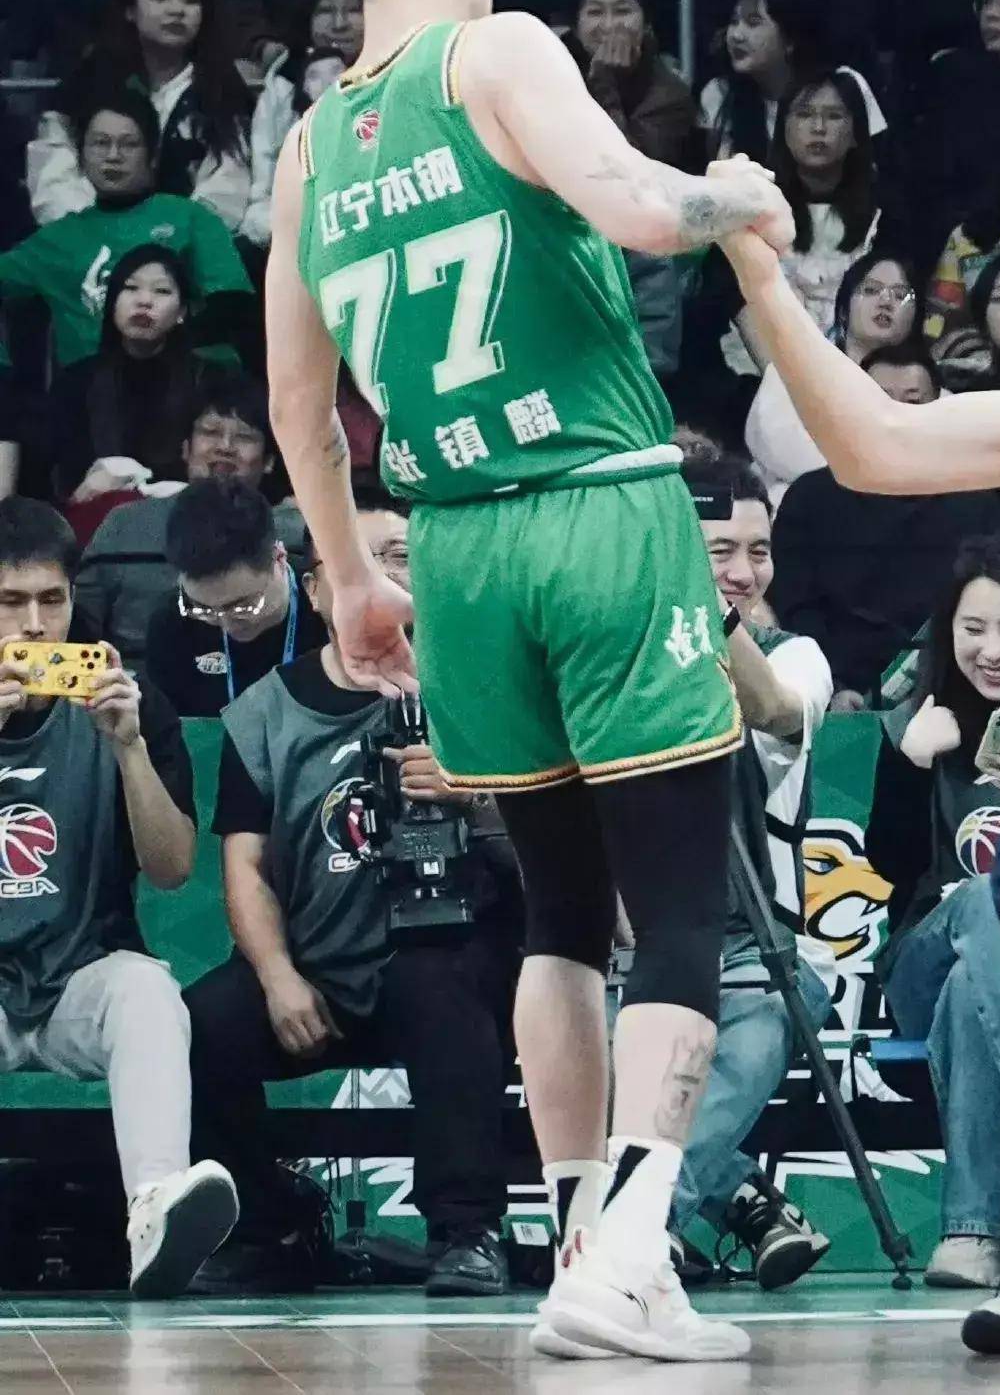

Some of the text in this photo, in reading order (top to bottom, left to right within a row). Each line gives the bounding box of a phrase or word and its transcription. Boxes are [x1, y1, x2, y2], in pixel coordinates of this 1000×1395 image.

[319, 145, 464, 246] 辽宁本钢
[318, 208, 513, 416] 77
[0, 876, 60, 898] CBA
